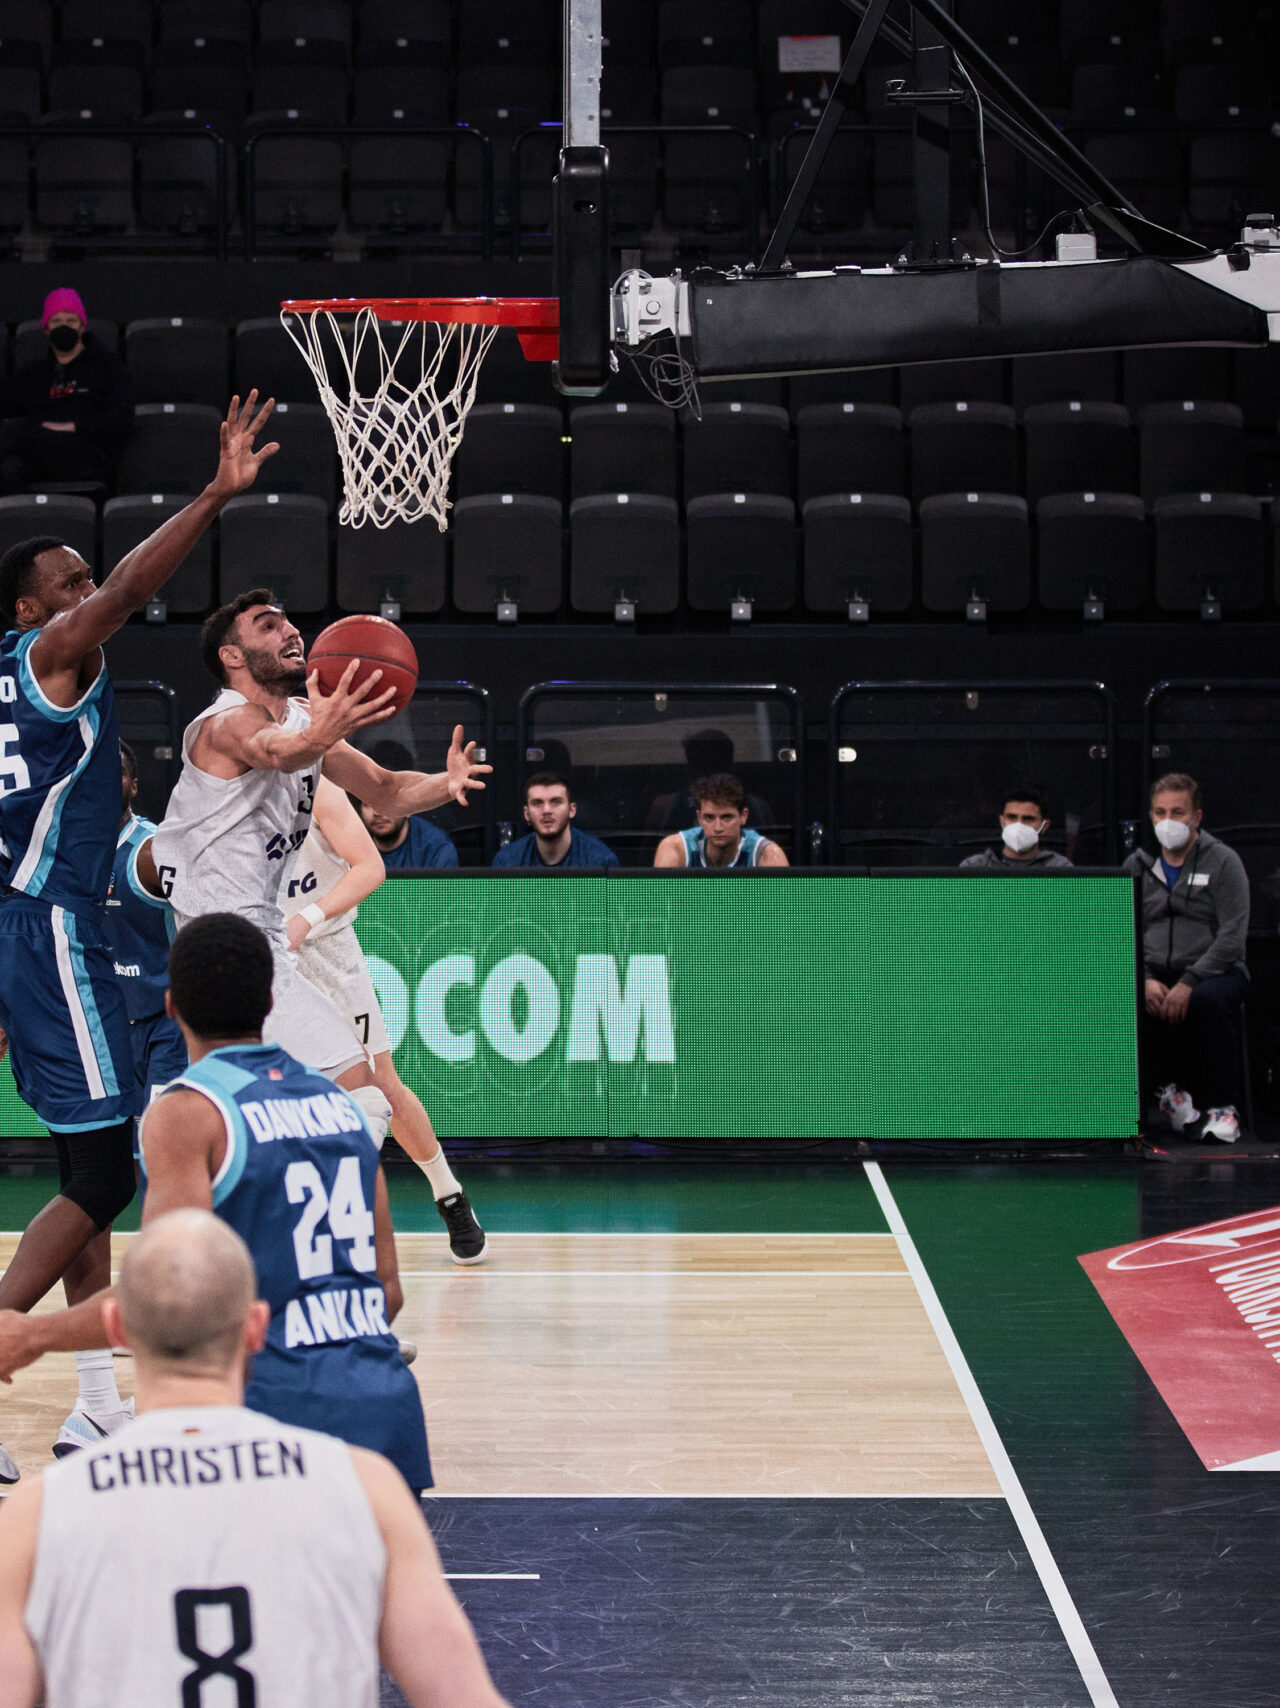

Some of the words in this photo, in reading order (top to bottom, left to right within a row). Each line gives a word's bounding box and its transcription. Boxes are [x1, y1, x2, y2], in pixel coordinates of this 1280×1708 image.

[355, 1013, 369, 1044] 7
[240, 1092, 363, 1144] DAWKINS
[284, 1156, 377, 1280] 24
[88, 1440, 307, 1491] CHRISTEN
[174, 1586, 255, 1708] 8
